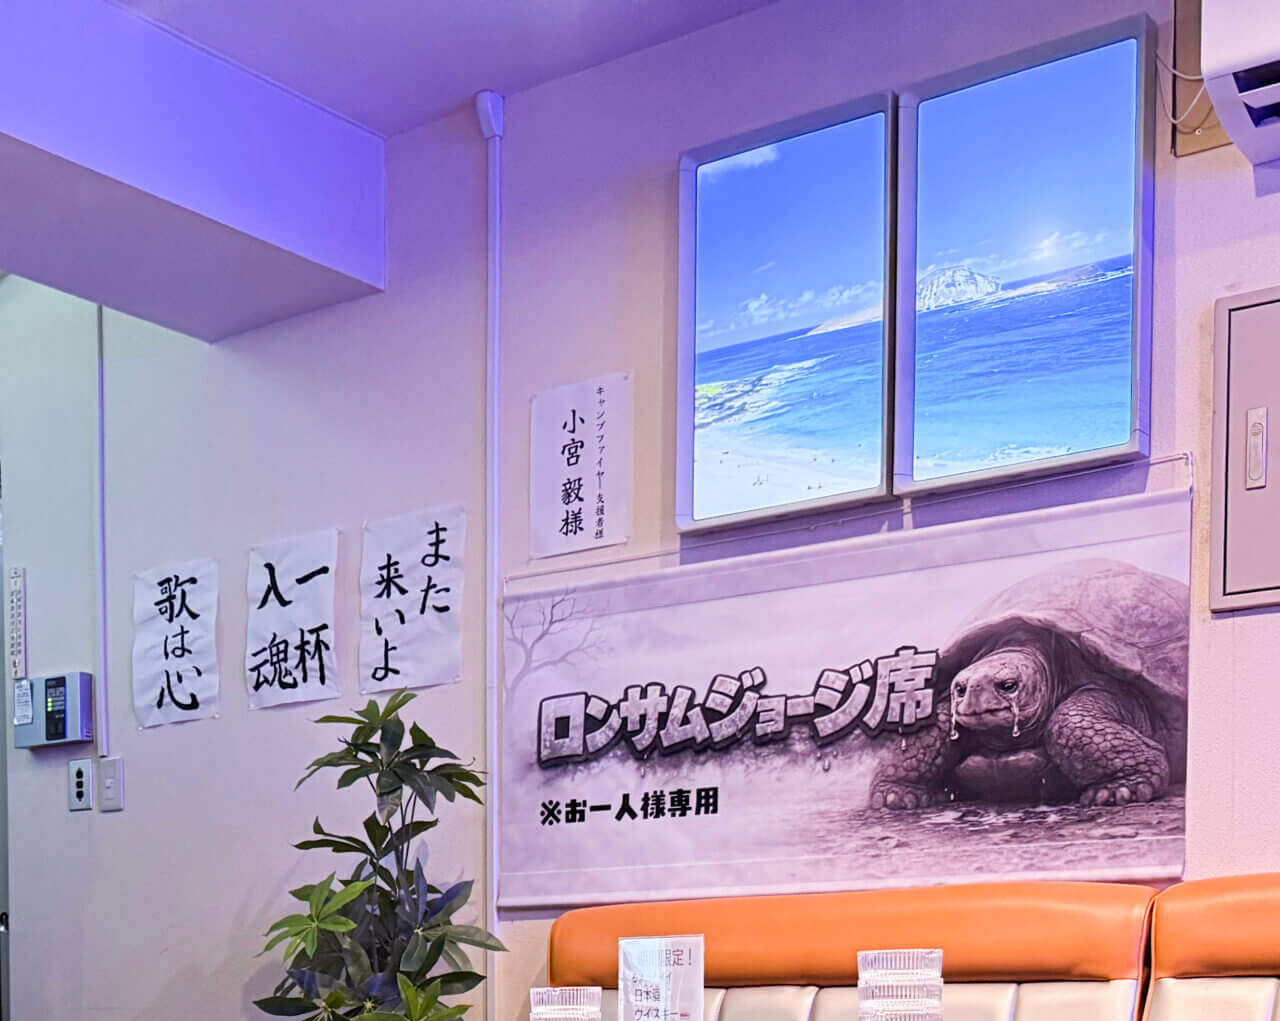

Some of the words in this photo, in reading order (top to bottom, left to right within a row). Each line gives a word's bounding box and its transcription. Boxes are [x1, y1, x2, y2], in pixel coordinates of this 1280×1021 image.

[561, 409, 585, 467] 小宮
[248, 562, 298, 692] 入魂
[294, 564, 332, 687] 一杯
[371, 553, 409, 682] 来いよ
[419, 521, 451, 616] また
[154, 574, 203, 711] 歌は心
[537, 645, 940, 769] ロンサムジョージ席
[540, 786, 719, 827] ※お一人様専用
